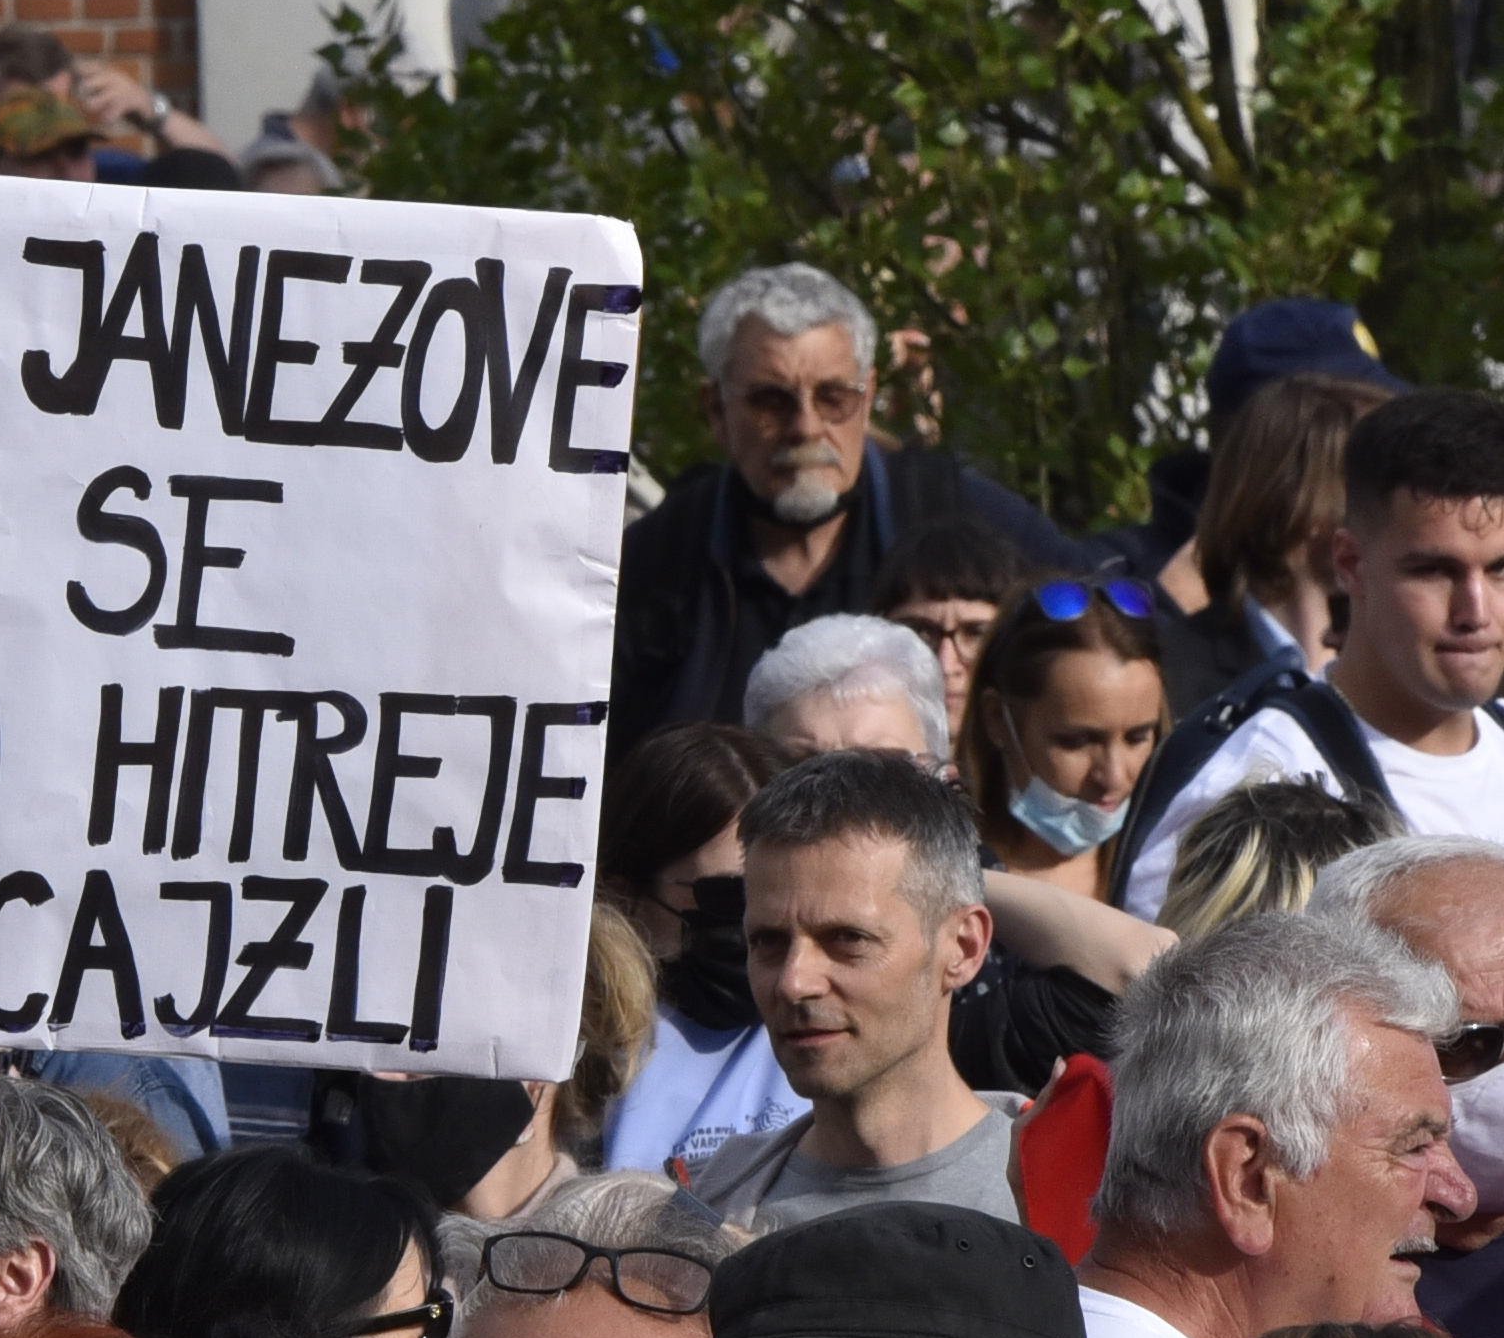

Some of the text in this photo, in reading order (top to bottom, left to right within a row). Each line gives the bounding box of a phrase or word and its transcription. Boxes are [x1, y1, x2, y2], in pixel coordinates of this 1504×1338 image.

[21, 232, 642, 474] JANEZOVE
[67, 466, 295, 657] SE
[88, 683, 608, 889] HITREJE
